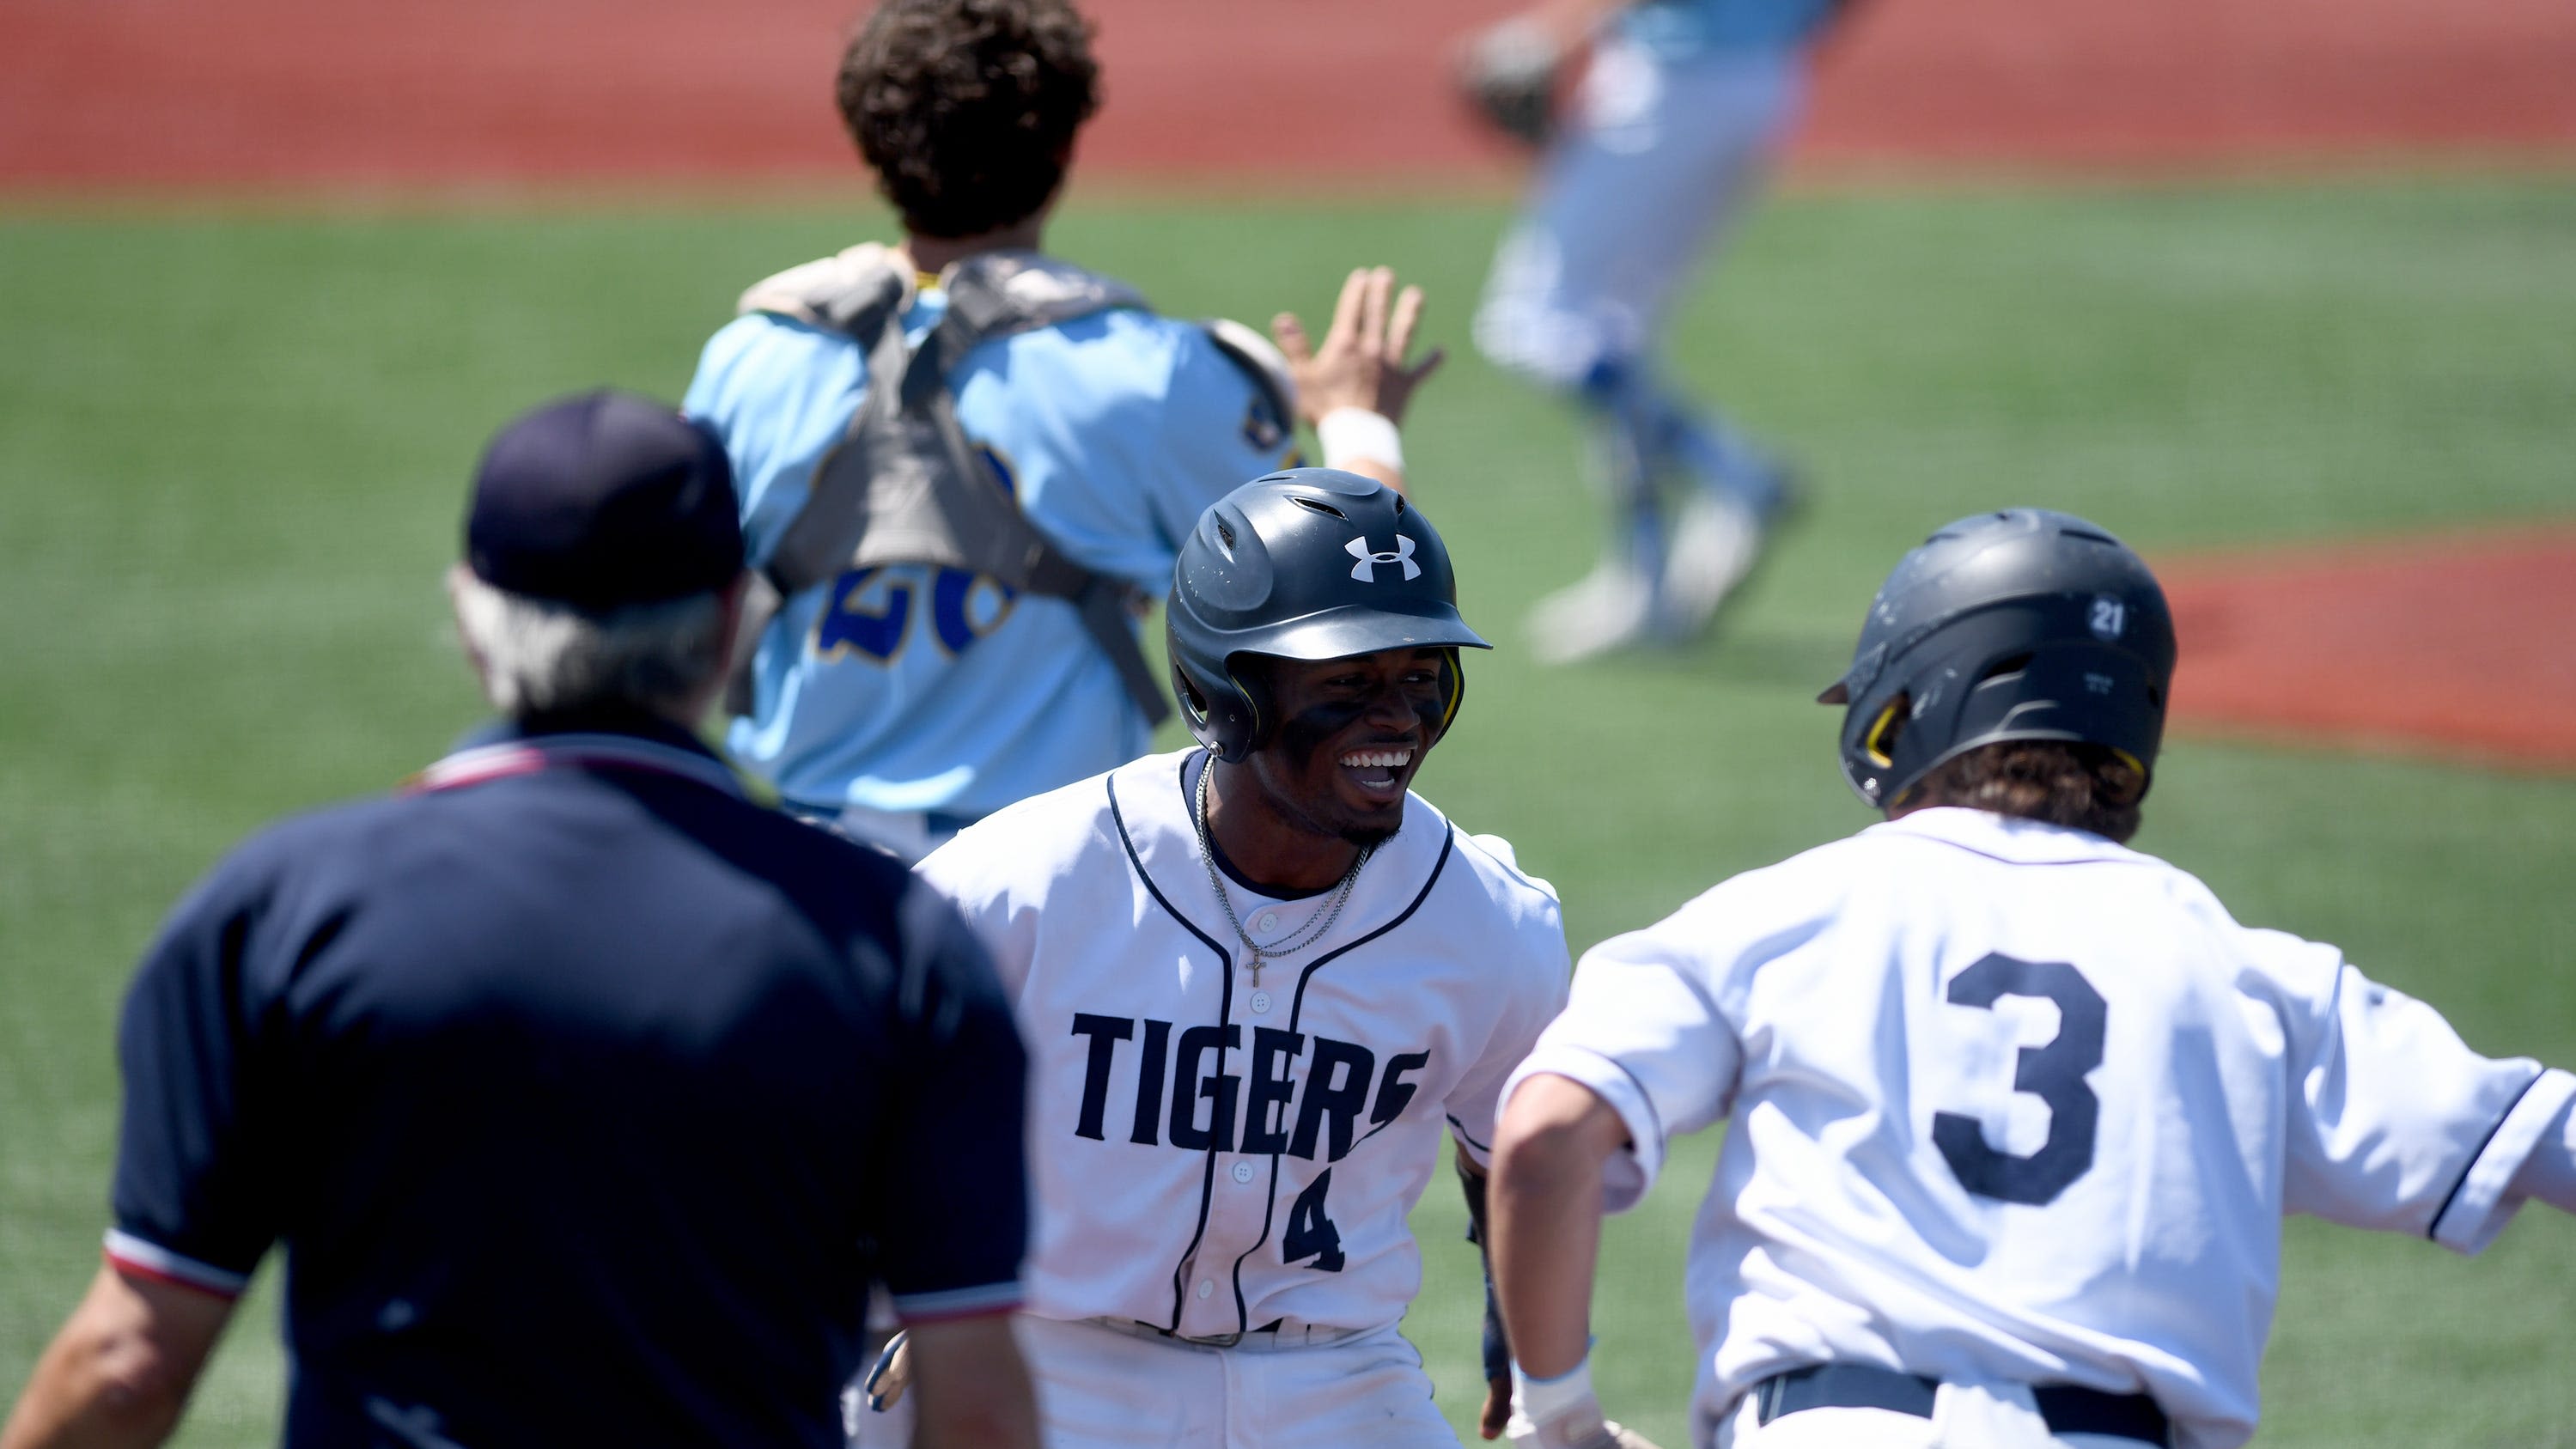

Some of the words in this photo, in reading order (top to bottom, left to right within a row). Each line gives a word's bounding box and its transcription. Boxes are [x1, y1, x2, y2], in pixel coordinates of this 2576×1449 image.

[2091, 599, 2123, 636] 21
[1071, 1012, 1431, 1164] TIGERS
[1930, 950, 2108, 1208] 3
[1282, 1166, 1345, 1273] 4
